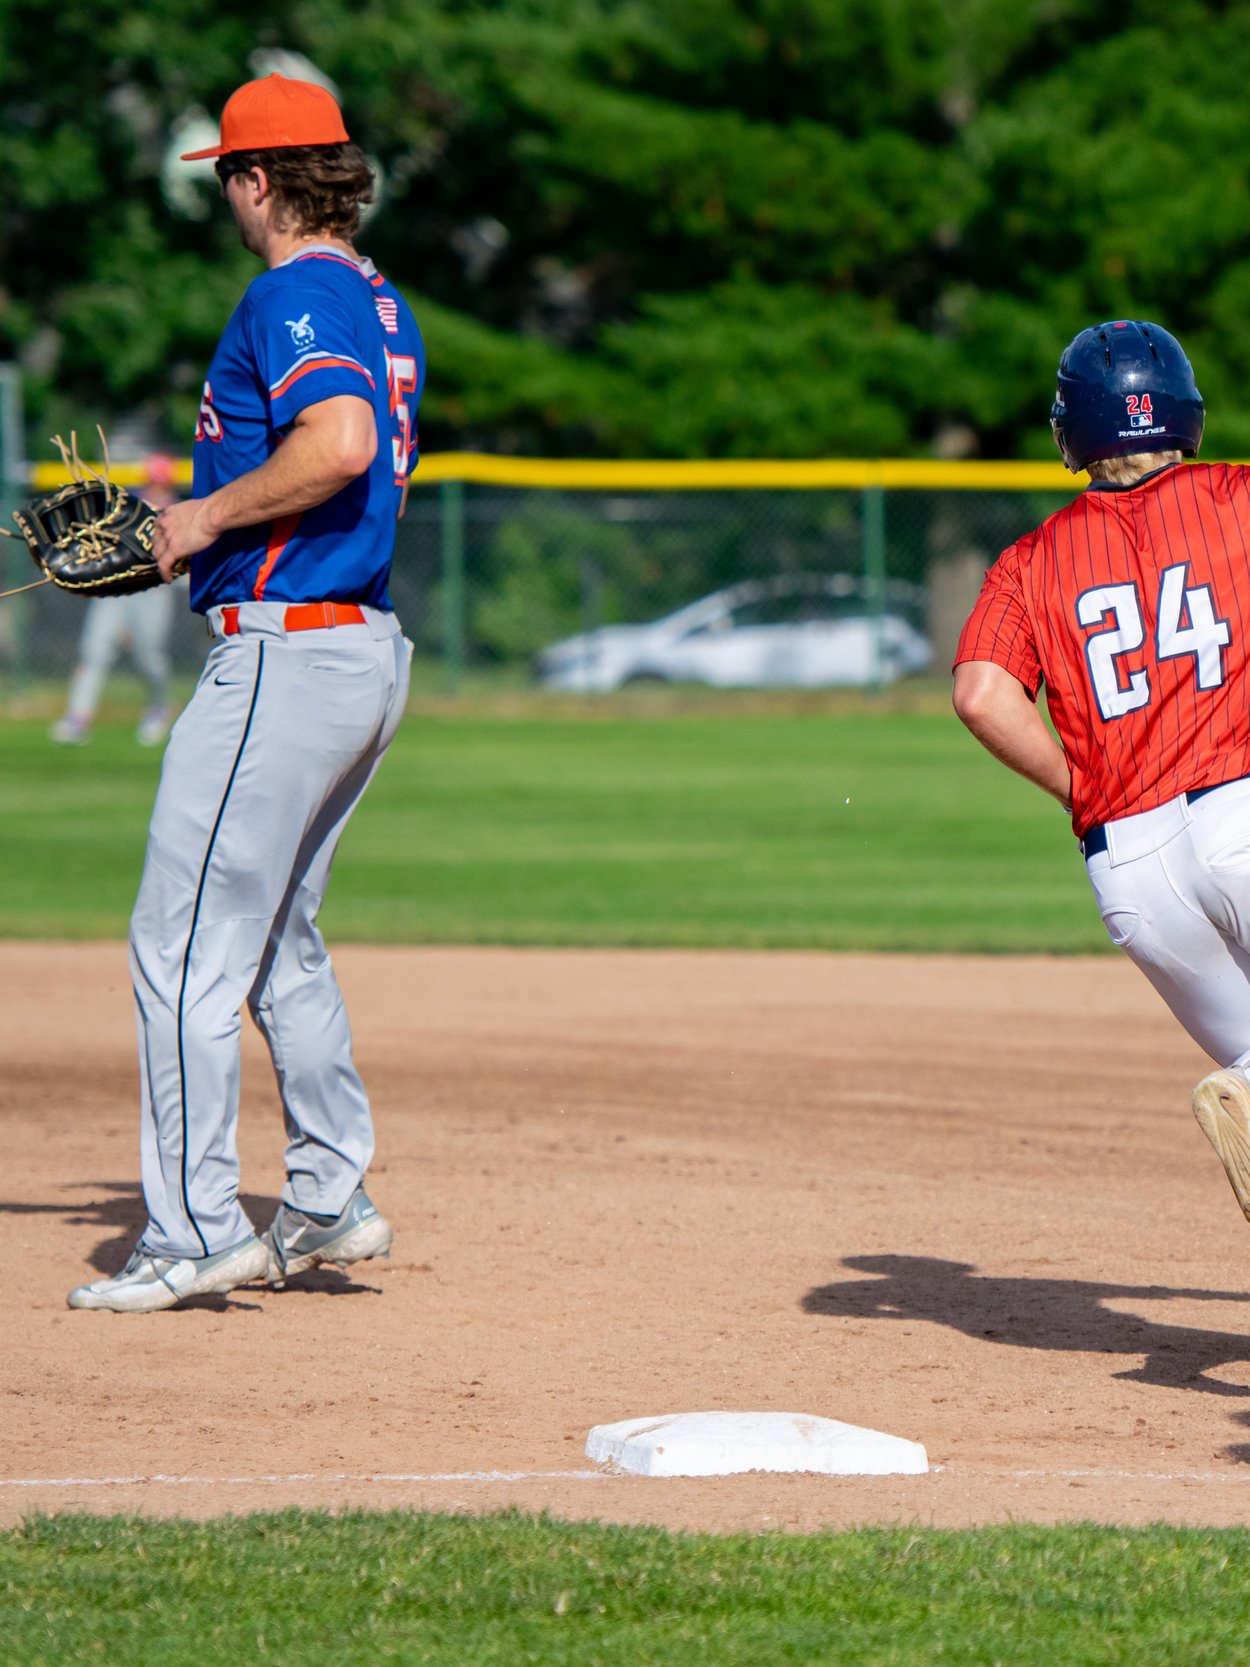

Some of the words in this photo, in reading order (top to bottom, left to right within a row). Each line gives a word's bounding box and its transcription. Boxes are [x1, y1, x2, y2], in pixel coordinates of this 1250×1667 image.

[1126, 394, 1153, 414] 24
[1118, 426, 1166, 437] RAWLINGS
[1074, 560, 1233, 724] 24
